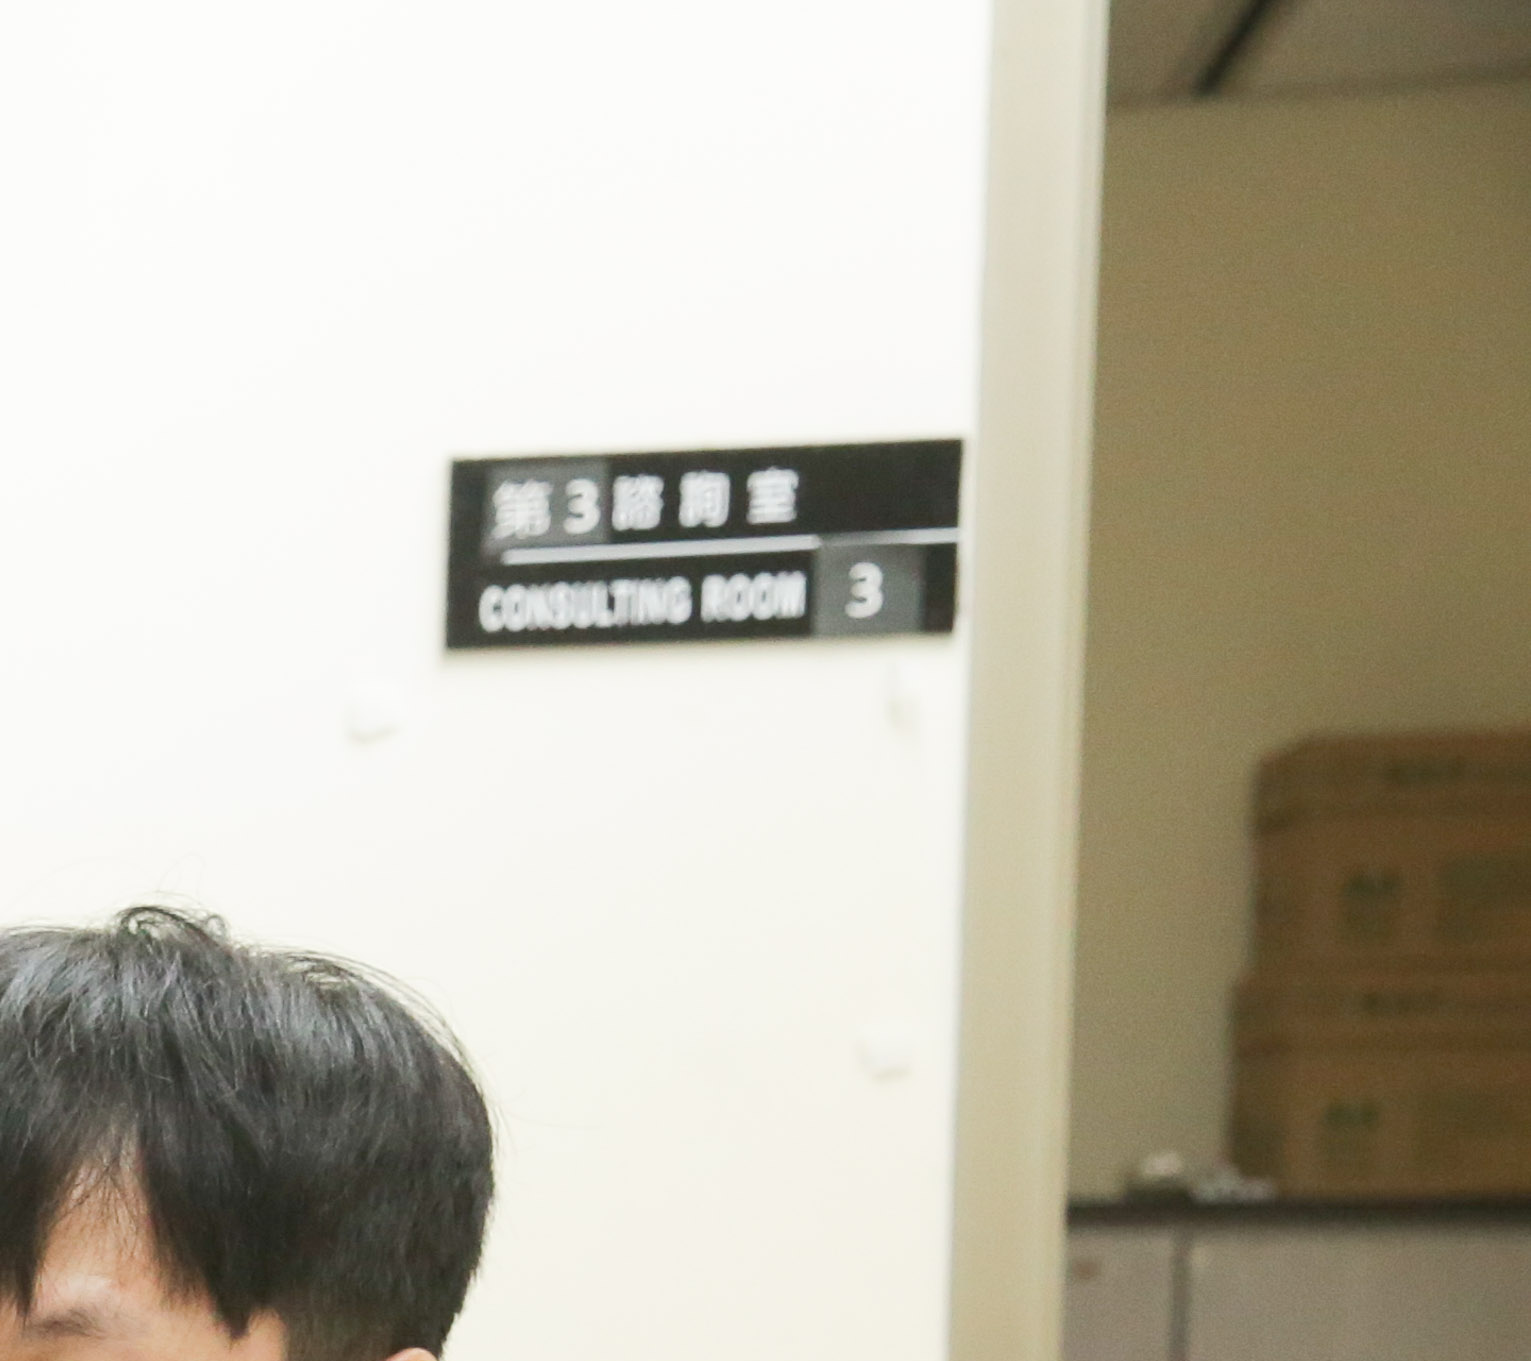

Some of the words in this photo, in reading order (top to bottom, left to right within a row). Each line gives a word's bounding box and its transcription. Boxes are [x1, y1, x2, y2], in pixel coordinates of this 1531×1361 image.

[478, 576, 693, 633] CONSULTING
[700, 570, 807, 623] ROOM
[844, 561, 885, 619] 3
